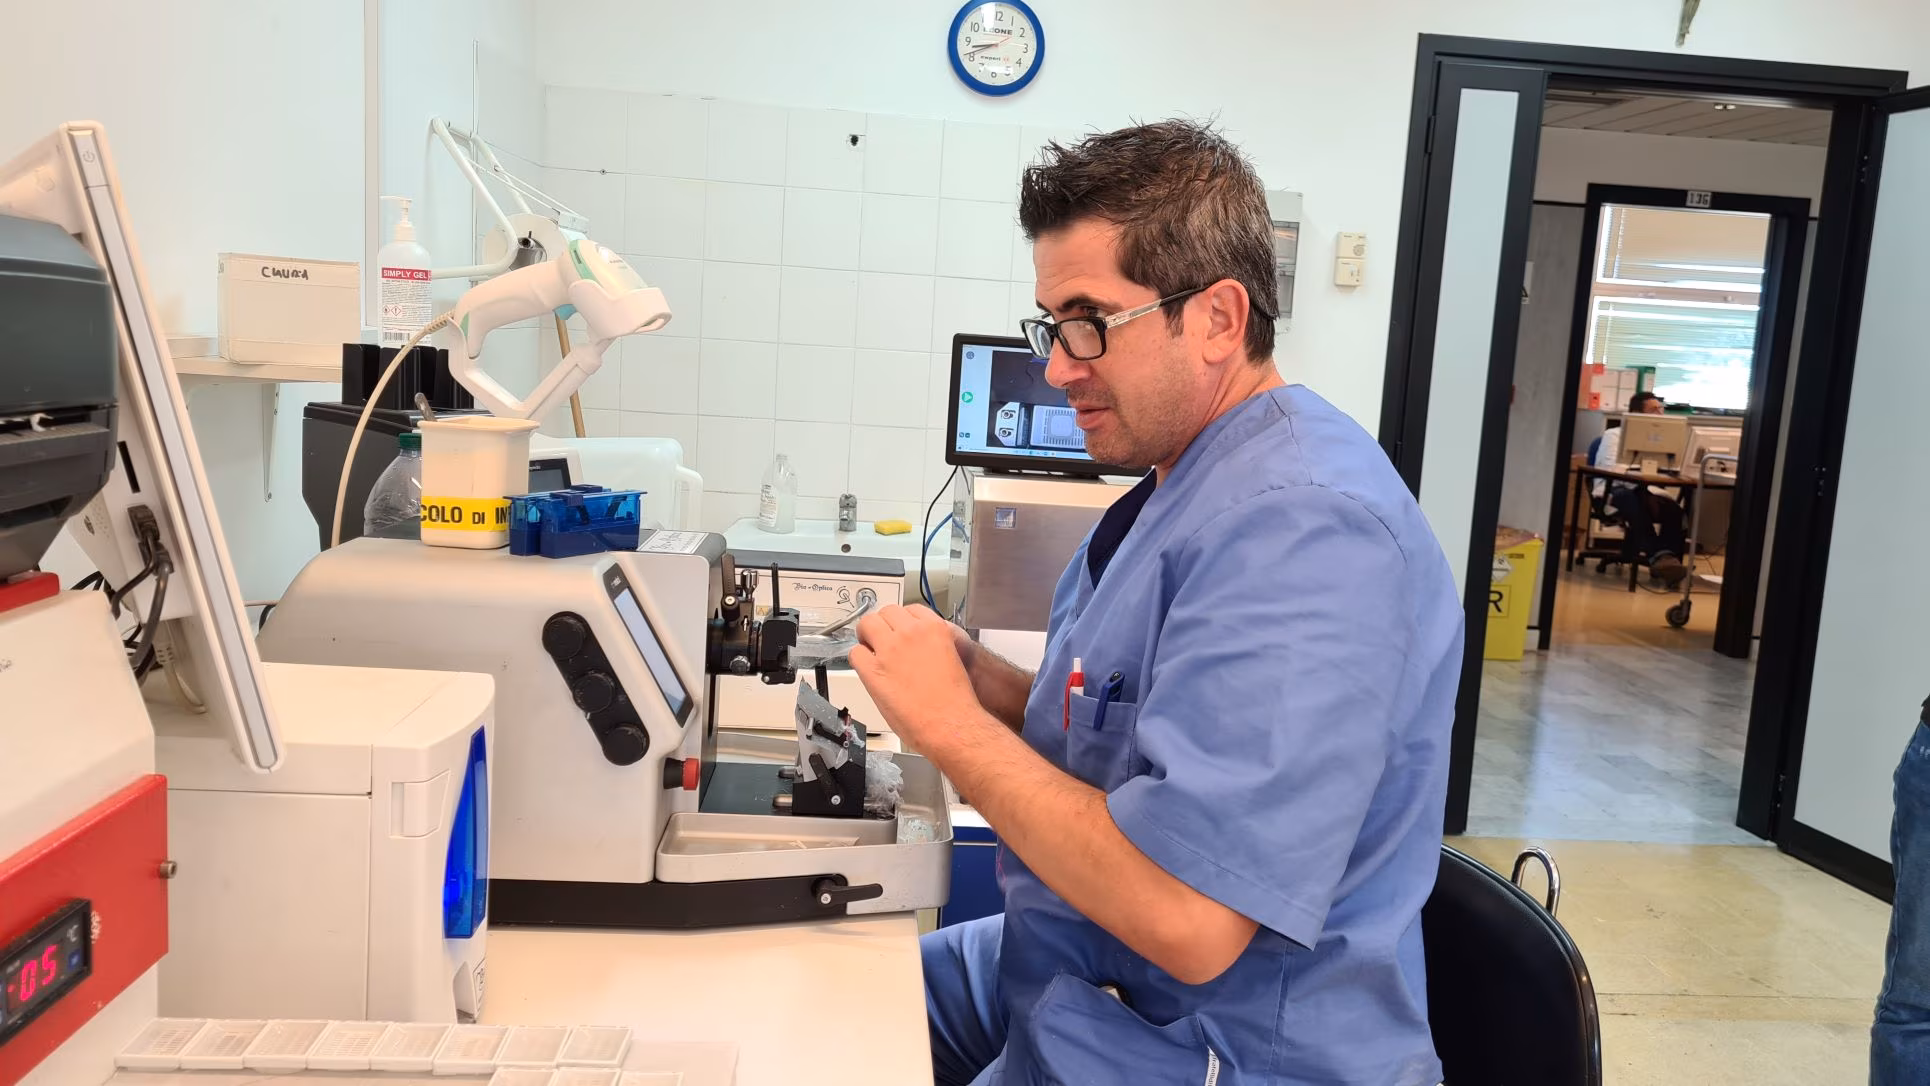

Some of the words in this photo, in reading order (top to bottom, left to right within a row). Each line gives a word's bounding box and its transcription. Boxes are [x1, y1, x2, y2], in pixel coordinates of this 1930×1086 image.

[995, 11, 1004, 22] 12
[970, 21, 980, 32] 10
[1019, 28, 1026, 38] 2
[965, 36, 971, 46] 9
[1022, 43, 1029, 54] 3
[968, 52, 975, 62] 8
[1015, 57, 1022, 68] 4
[383, 269, 412, 278] SIMPLY
[413, 271, 428, 279] GEL
[472, 511, 486, 525] DI
